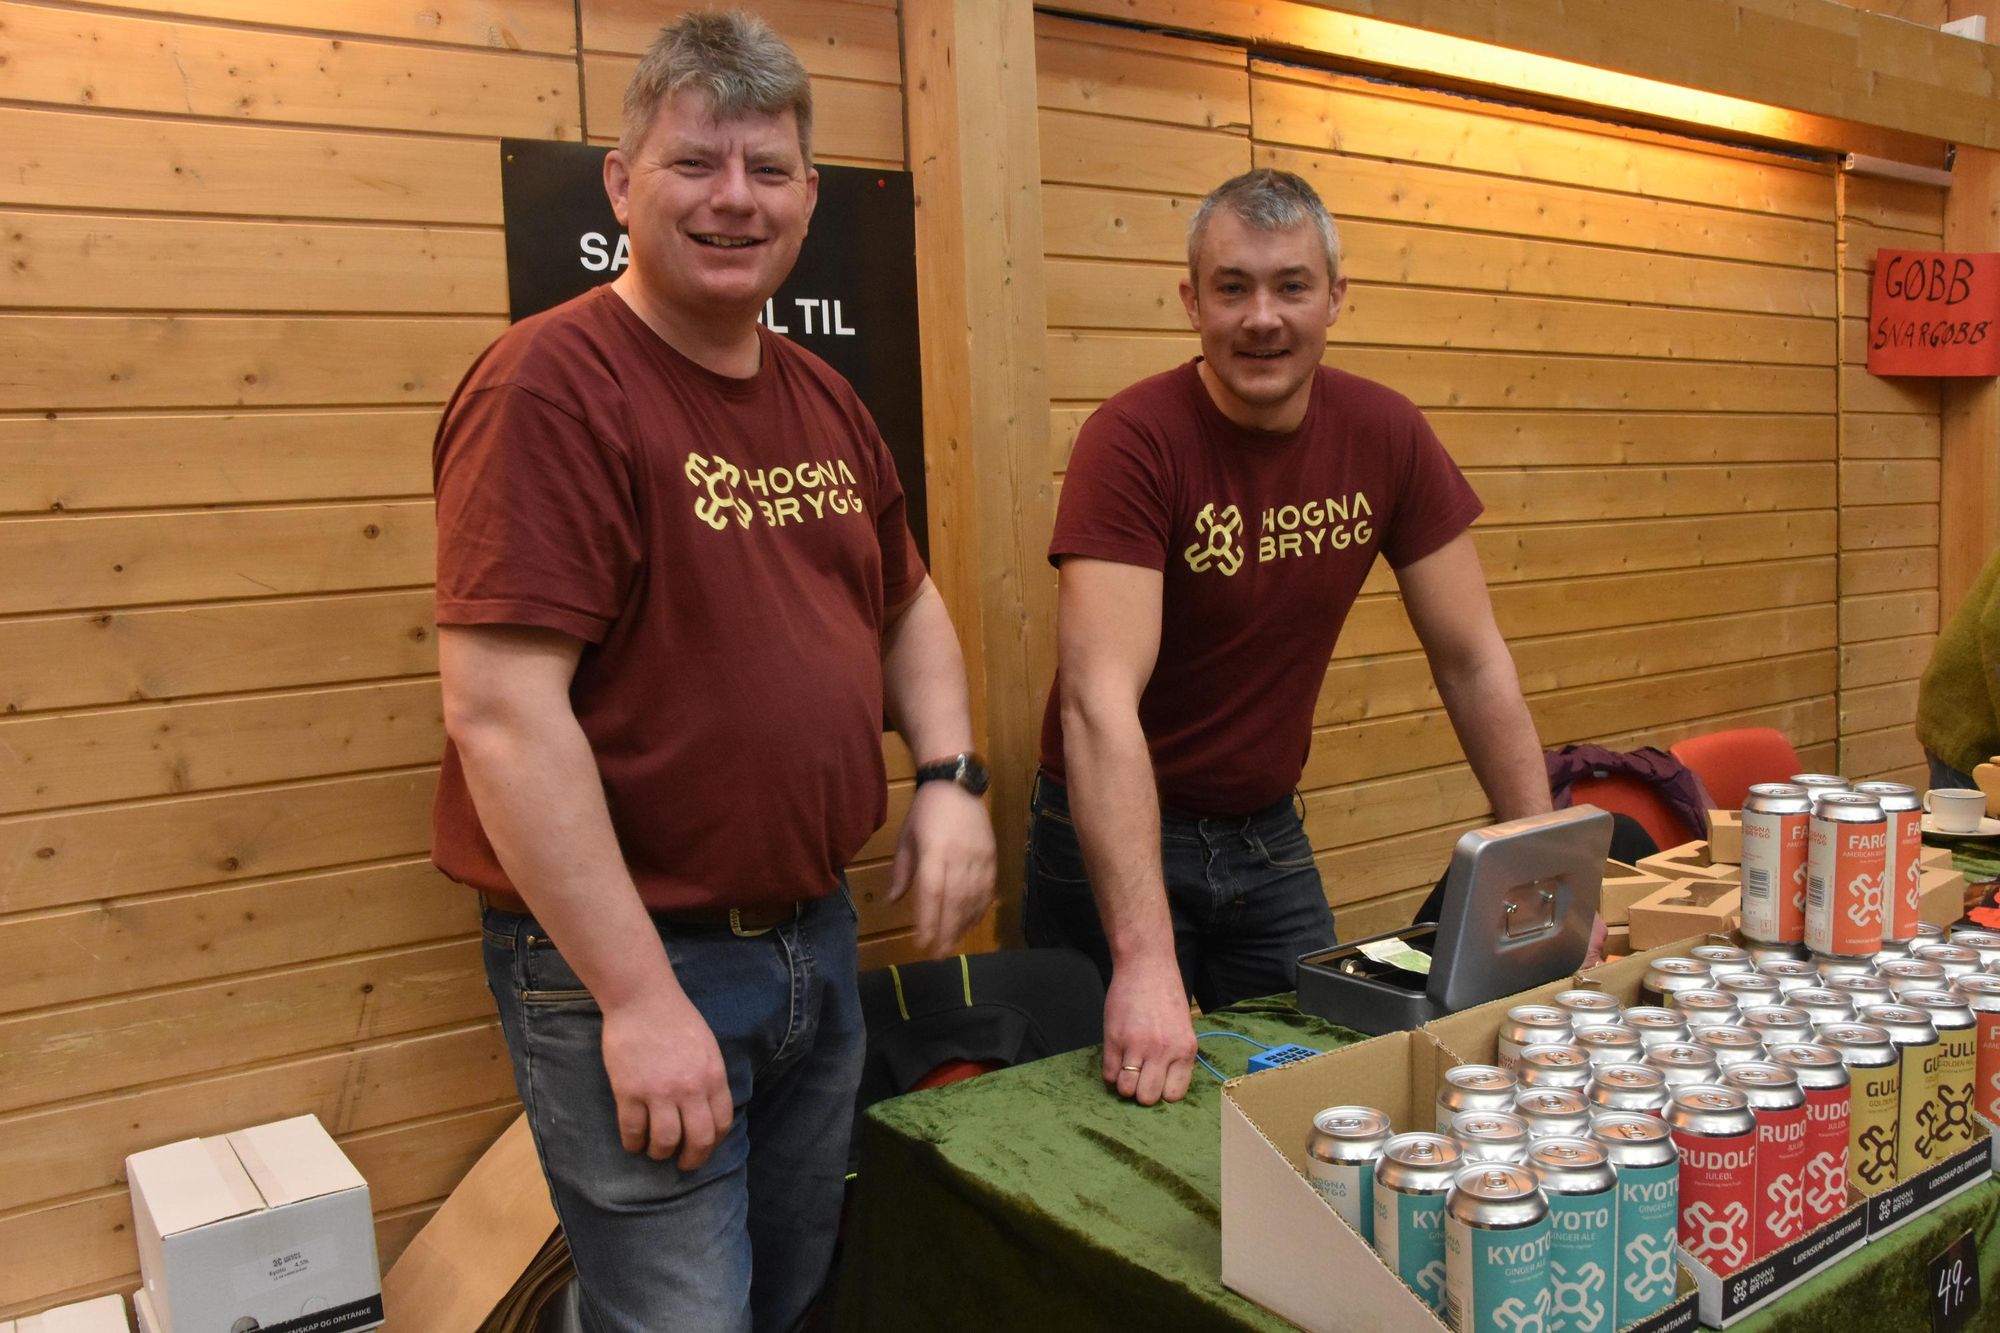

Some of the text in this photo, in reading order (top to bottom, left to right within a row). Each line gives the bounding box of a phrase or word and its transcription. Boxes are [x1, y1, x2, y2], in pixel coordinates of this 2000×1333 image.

[579, 231, 631, 272] SA
[795, 298, 856, 336] TIL
[743, 459, 857, 497] HOGNA
[756, 488, 863, 527] BRYGG
[1262, 491, 1374, 533] HOGNA
[1258, 520, 1373, 563] BRYGG
[1848, 832, 1887, 849] FARG
[1866, 1078, 1900, 1098] GUL
[1806, 1099, 1850, 1121] RUDO
[1759, 1119, 1807, 1143] RUDO
[1679, 1146, 1755, 1170] RUDOLF
[1549, 1207, 1609, 1231] YOTO
[320, 1318, 332, 1329] OG
[332, 1306, 372, 1325] OMTANKE
